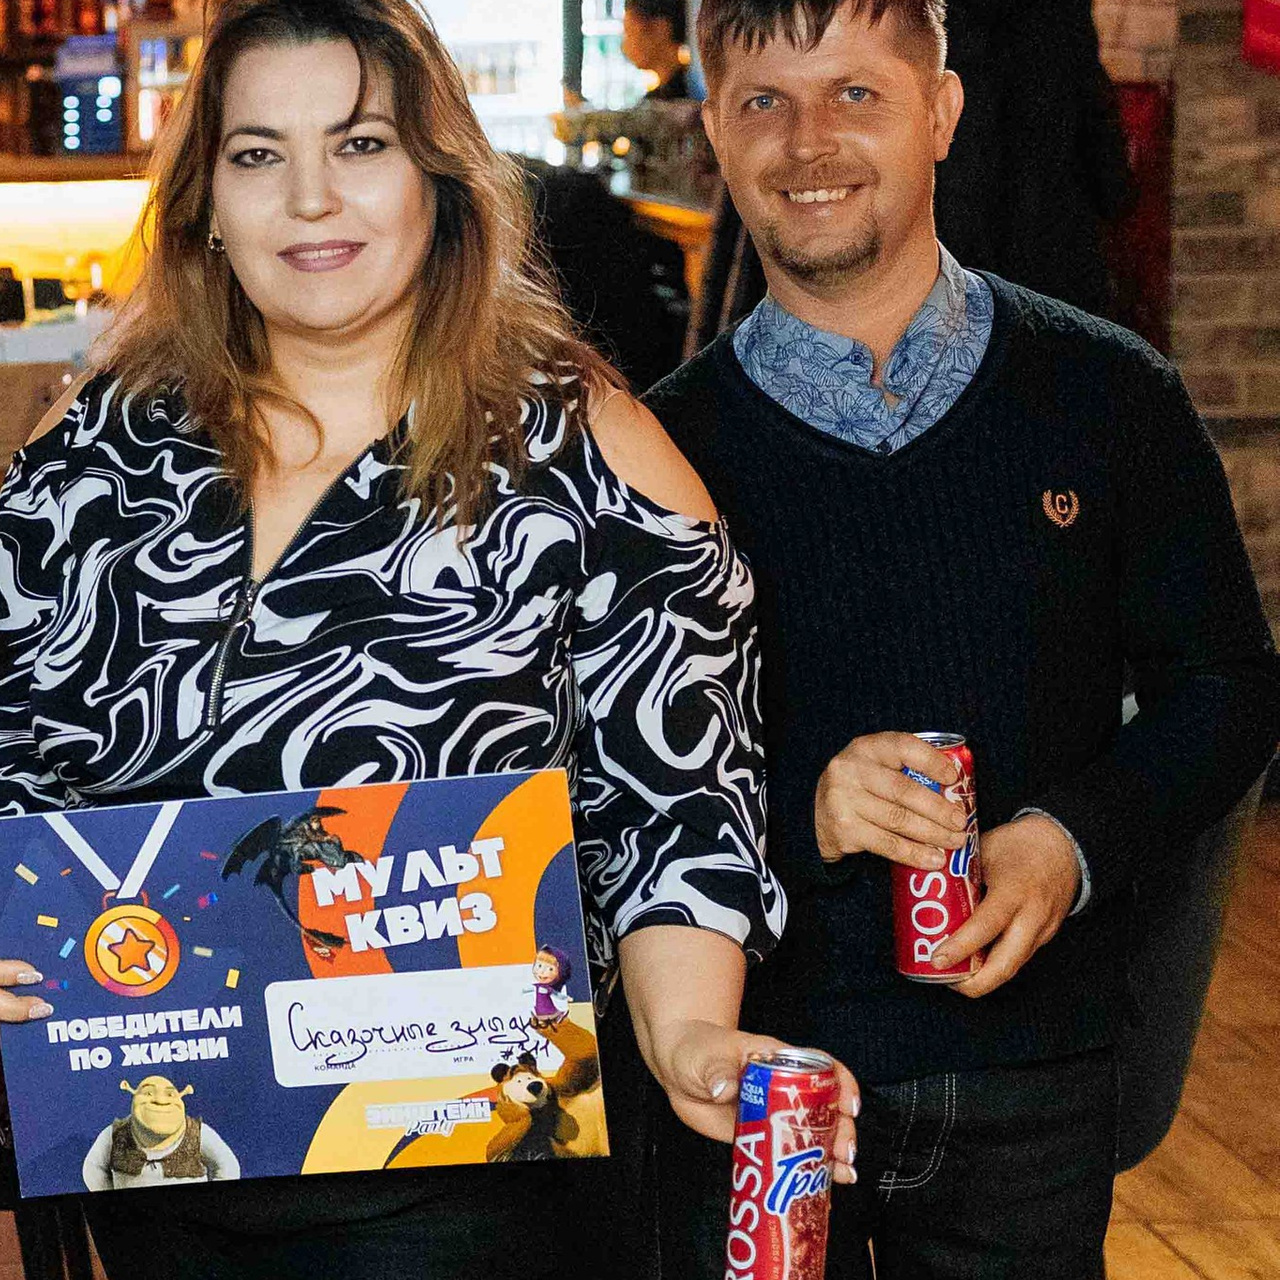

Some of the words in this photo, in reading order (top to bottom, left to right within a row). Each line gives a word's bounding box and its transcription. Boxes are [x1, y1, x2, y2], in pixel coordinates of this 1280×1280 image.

[311, 837, 505, 906] МУЛЬТ
[345, 892, 497, 952] КВИЗ
[47, 1006, 242, 1043] ПОБЕДИТЕЛИ
[288, 1002, 438, 1064] Сказочные
[69, 1046, 111, 1070] ПО
[121, 1037, 229, 1067] ЖИЗНИ
[314, 1062, 356, 1072] КОМАНДА
